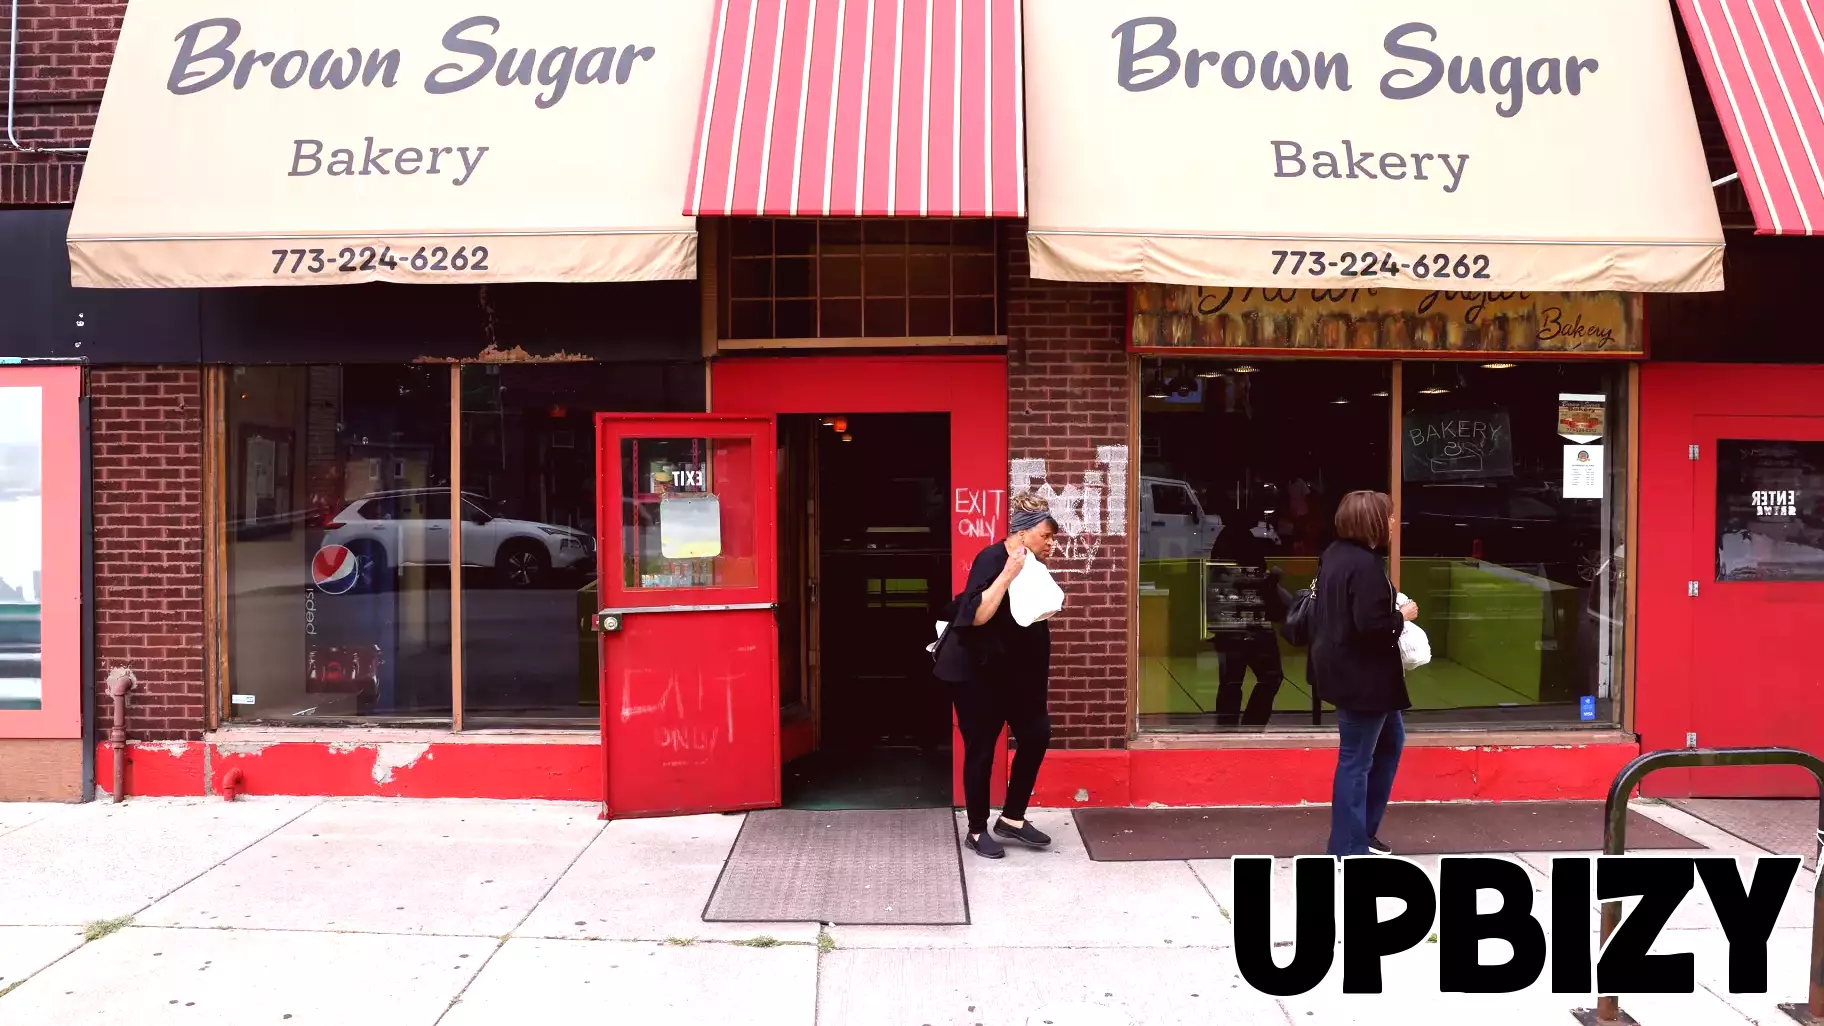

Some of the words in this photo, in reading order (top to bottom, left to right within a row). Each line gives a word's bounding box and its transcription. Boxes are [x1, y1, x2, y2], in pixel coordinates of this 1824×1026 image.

[166, 17, 401, 95] Brown
[424, 15, 656, 109] Sugar
[1111, 16, 1353, 92] Brown
[1379, 22, 1599, 118] Sugar
[287, 136, 490, 186] Bakery
[1270, 139, 1470, 193] Bakery
[271, 246, 489, 274] 773-224-6262
[1271, 250, 1491, 279] 773-224-6262
[1536, 307, 1615, 348] Bakery
[1410, 420, 1502, 446] BAKERY
[955, 487, 1005, 519] EXIT
[958, 515, 997, 545] ONLY
[1049, 535, 1101, 573] NLY
[306, 588, 316, 635] pepsi
